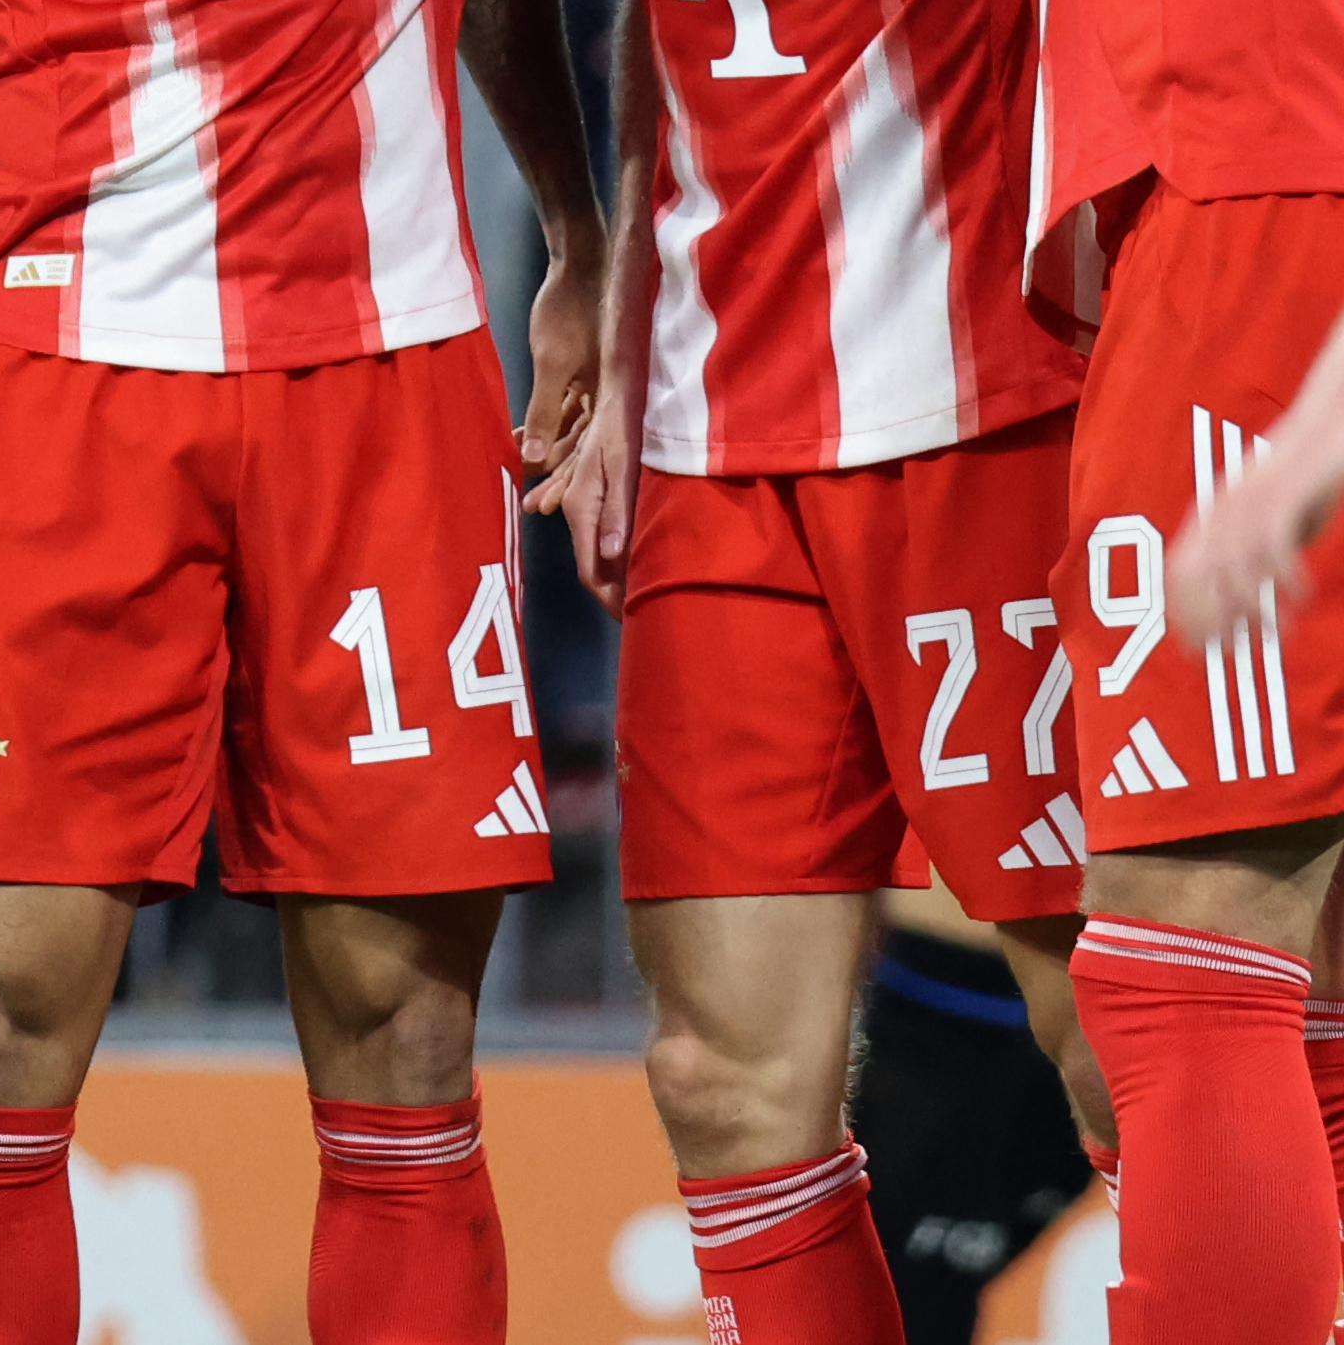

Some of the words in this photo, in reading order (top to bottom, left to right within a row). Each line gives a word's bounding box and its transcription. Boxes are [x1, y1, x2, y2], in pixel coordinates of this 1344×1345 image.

[328, 562, 534, 765] 14
[905, 597, 1074, 791] 27
[1087, 514, 1166, 697] 9
[706, 1311, 738, 1331] SAN
